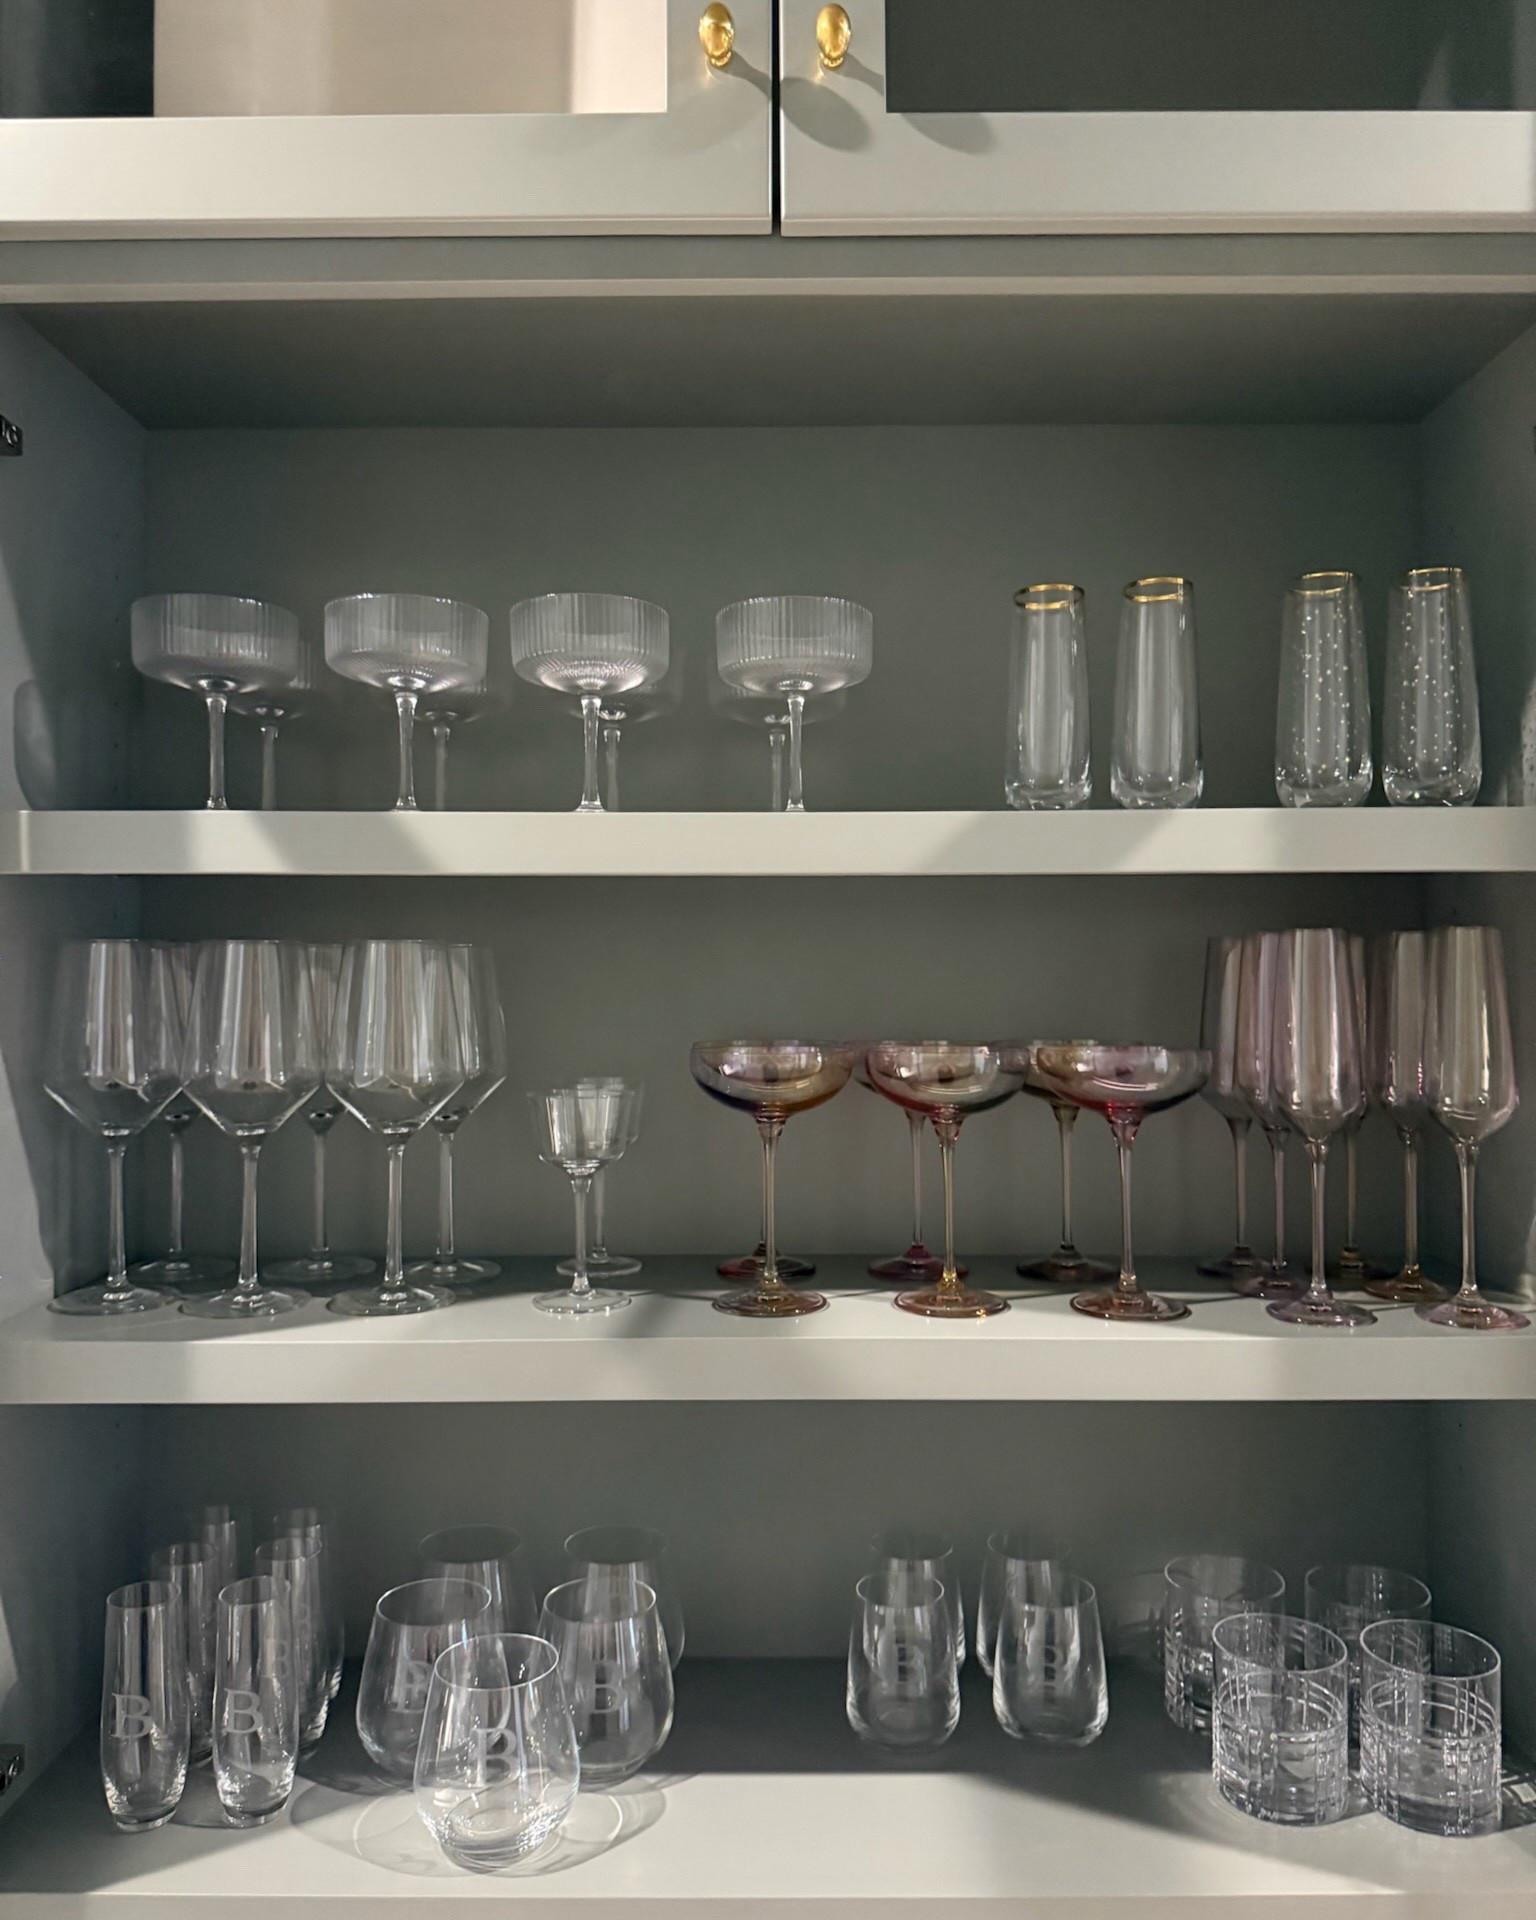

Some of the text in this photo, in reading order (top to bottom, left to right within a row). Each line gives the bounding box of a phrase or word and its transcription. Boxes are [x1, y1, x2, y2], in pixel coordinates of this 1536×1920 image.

[223, 1688, 261, 1734] B
[584, 1661, 626, 1713] B
[111, 1692, 152, 1739] B
[471, 1728, 521, 1787] B
